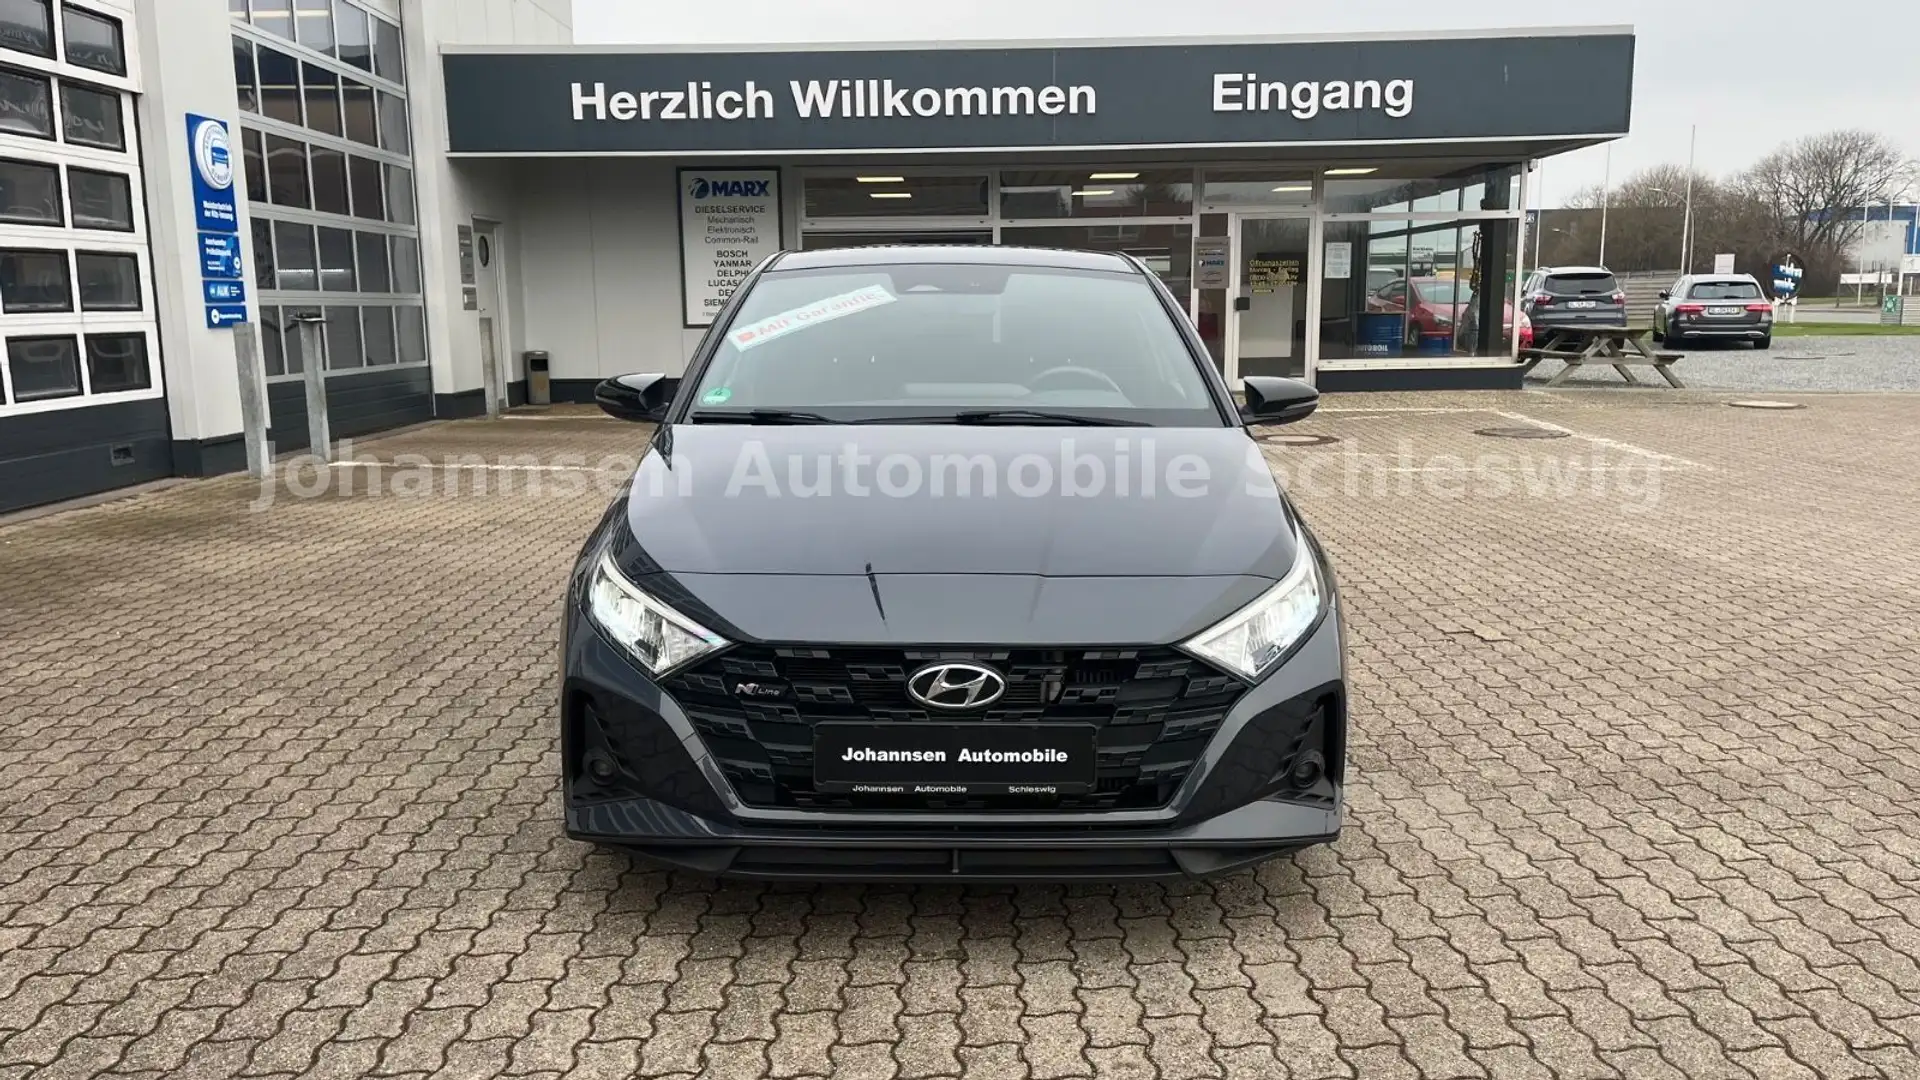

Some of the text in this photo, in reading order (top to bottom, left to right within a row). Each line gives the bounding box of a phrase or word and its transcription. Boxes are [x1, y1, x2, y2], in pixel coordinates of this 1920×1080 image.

[571, 79, 1097, 121] Herzlich Willkommen
[1213, 73, 1414, 119] Eingang
[711, 180, 770, 197] MARX
[694, 205, 766, 214] DIESELSERVICE
[707, 216, 756, 224] Mechanisch
[707, 226, 756, 234] Elektronisch
[704, 235, 759, 244] Common-Rail
[716, 250, 748, 258] BOSCH
[713, 260, 753, 268] YANMAR
[841, 747, 1069, 763] Johannsen Automobile
[852, 784, 1057, 794] Johannsen Automobile Schleswig
